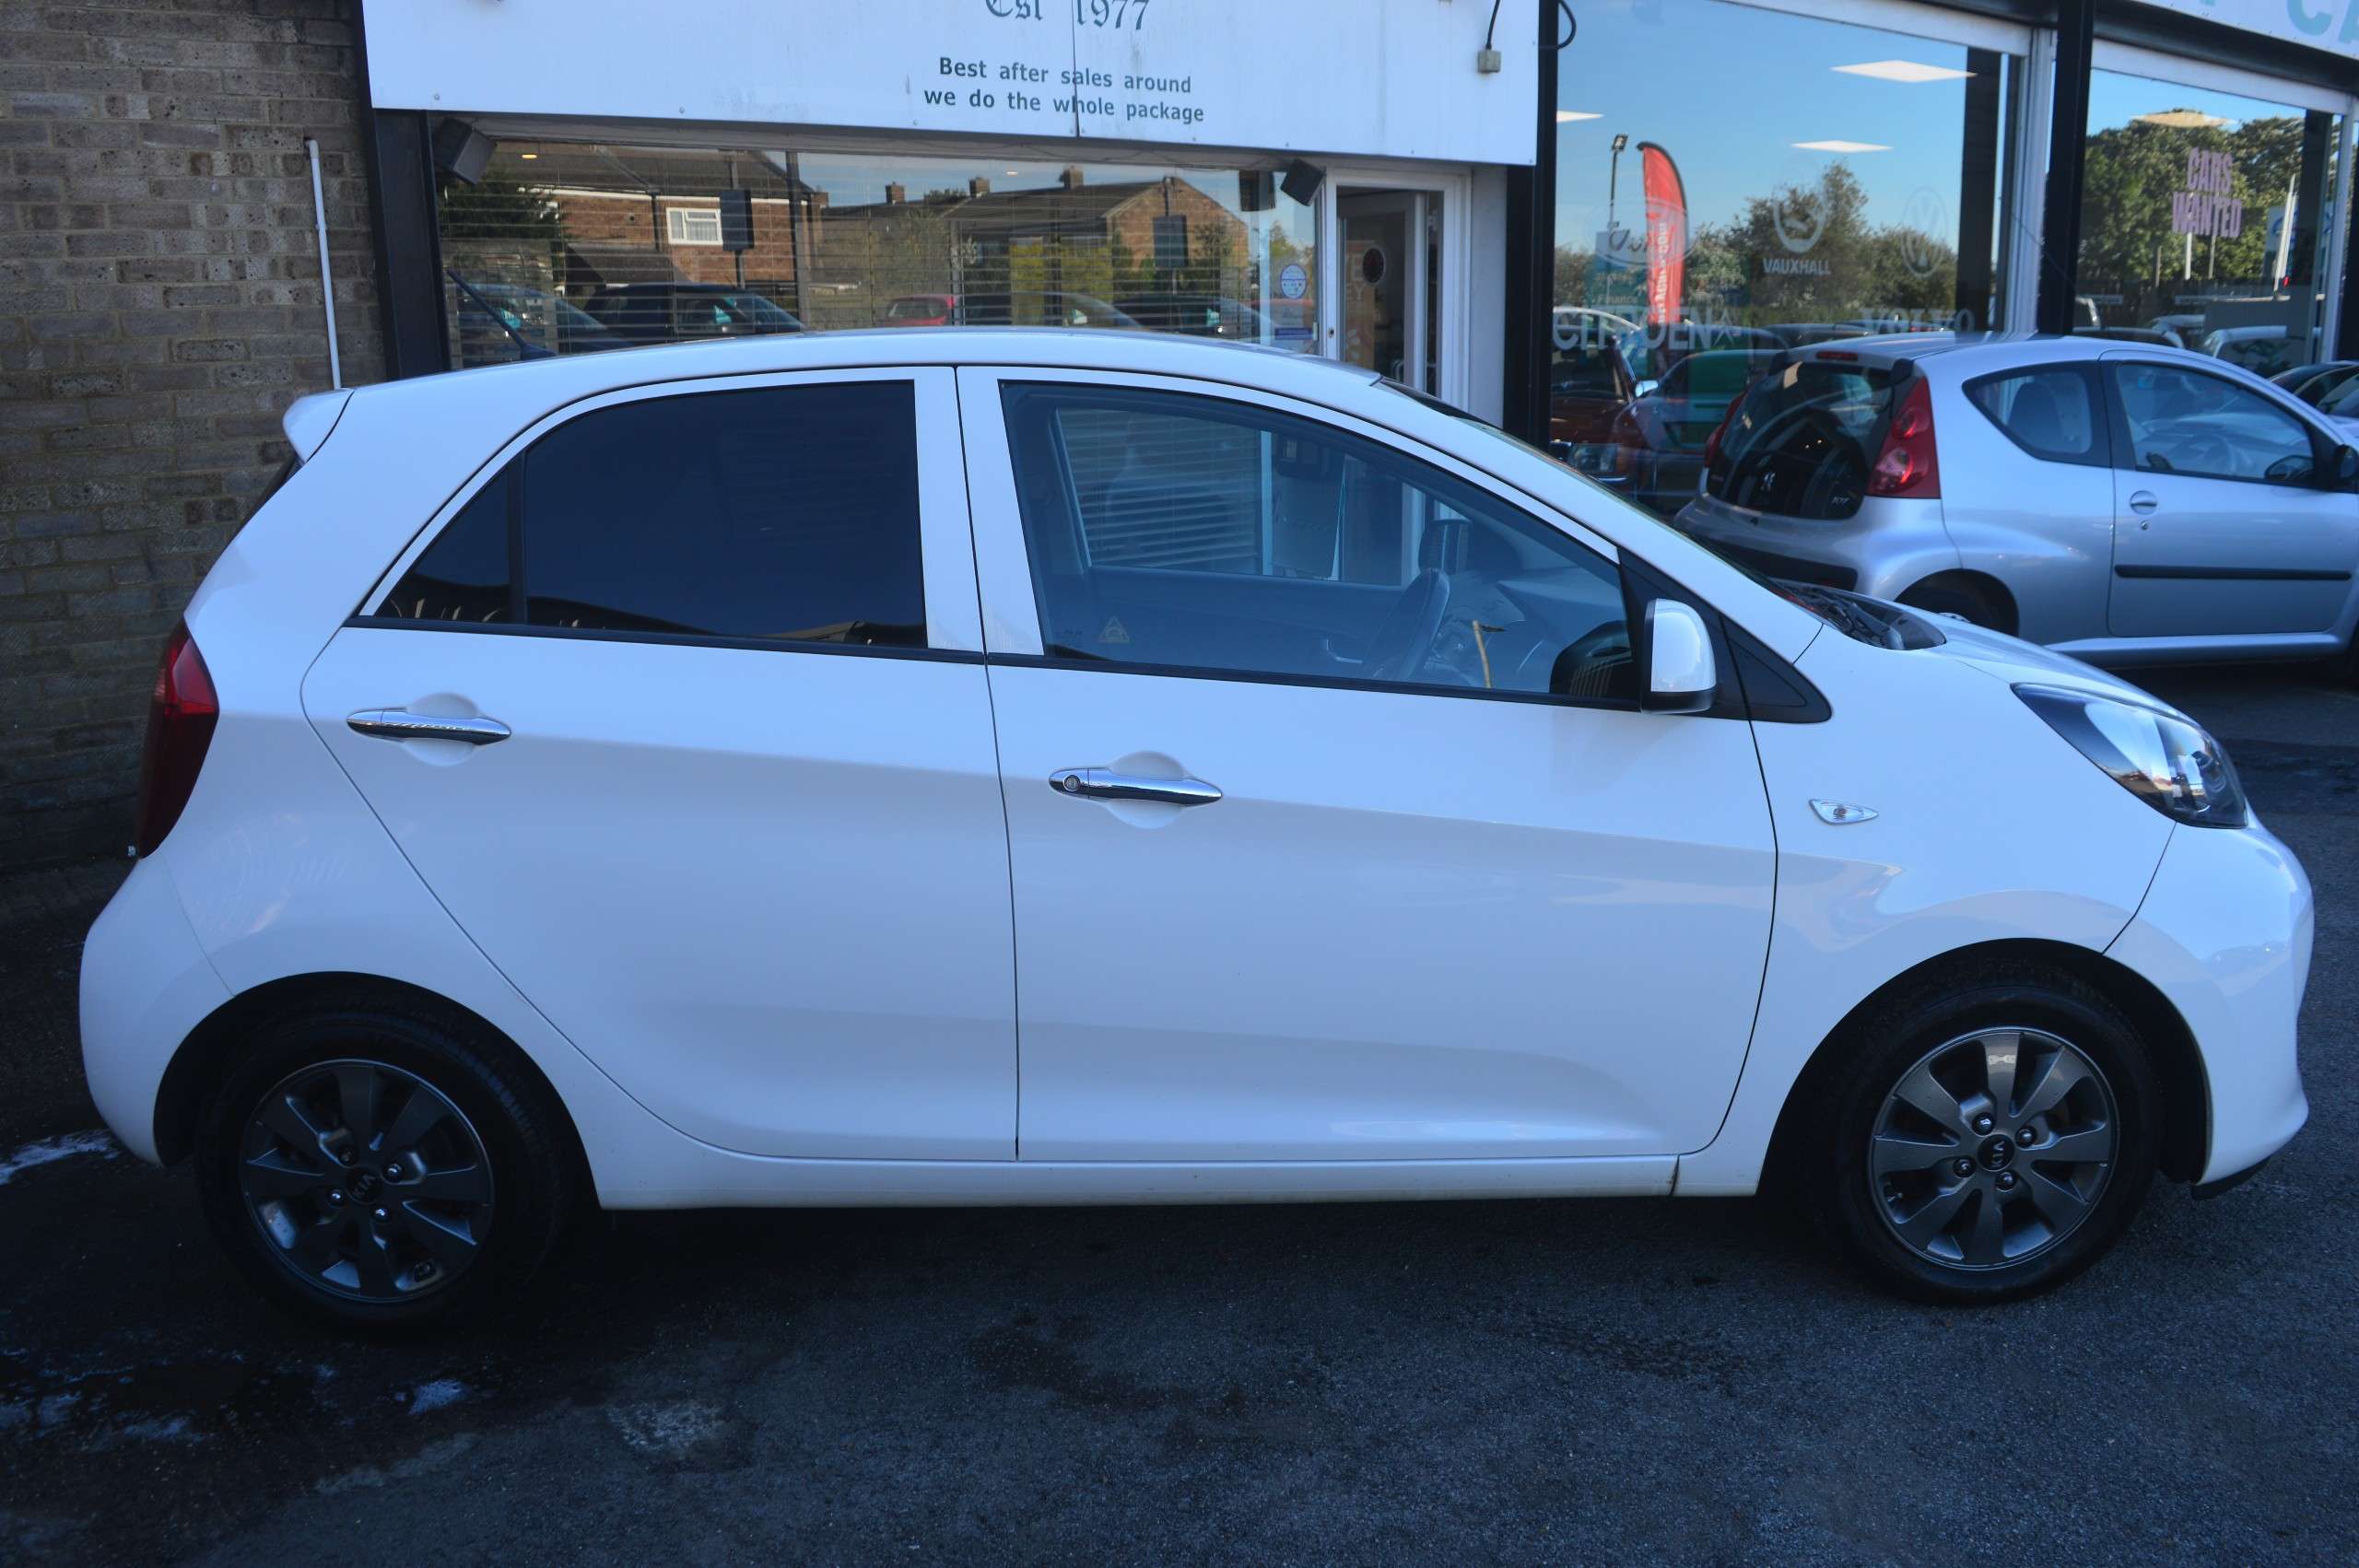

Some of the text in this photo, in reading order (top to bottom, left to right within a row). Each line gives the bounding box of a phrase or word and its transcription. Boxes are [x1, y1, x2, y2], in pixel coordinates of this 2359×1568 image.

[939, 56, 1191, 94] Best after sales around
[924, 88, 1204, 125] we do the whole package
[2187, 147, 2235, 193] CARS
[2172, 192, 2243, 239] WANTED
[1763, 258, 1832, 275] VAUXHALL
